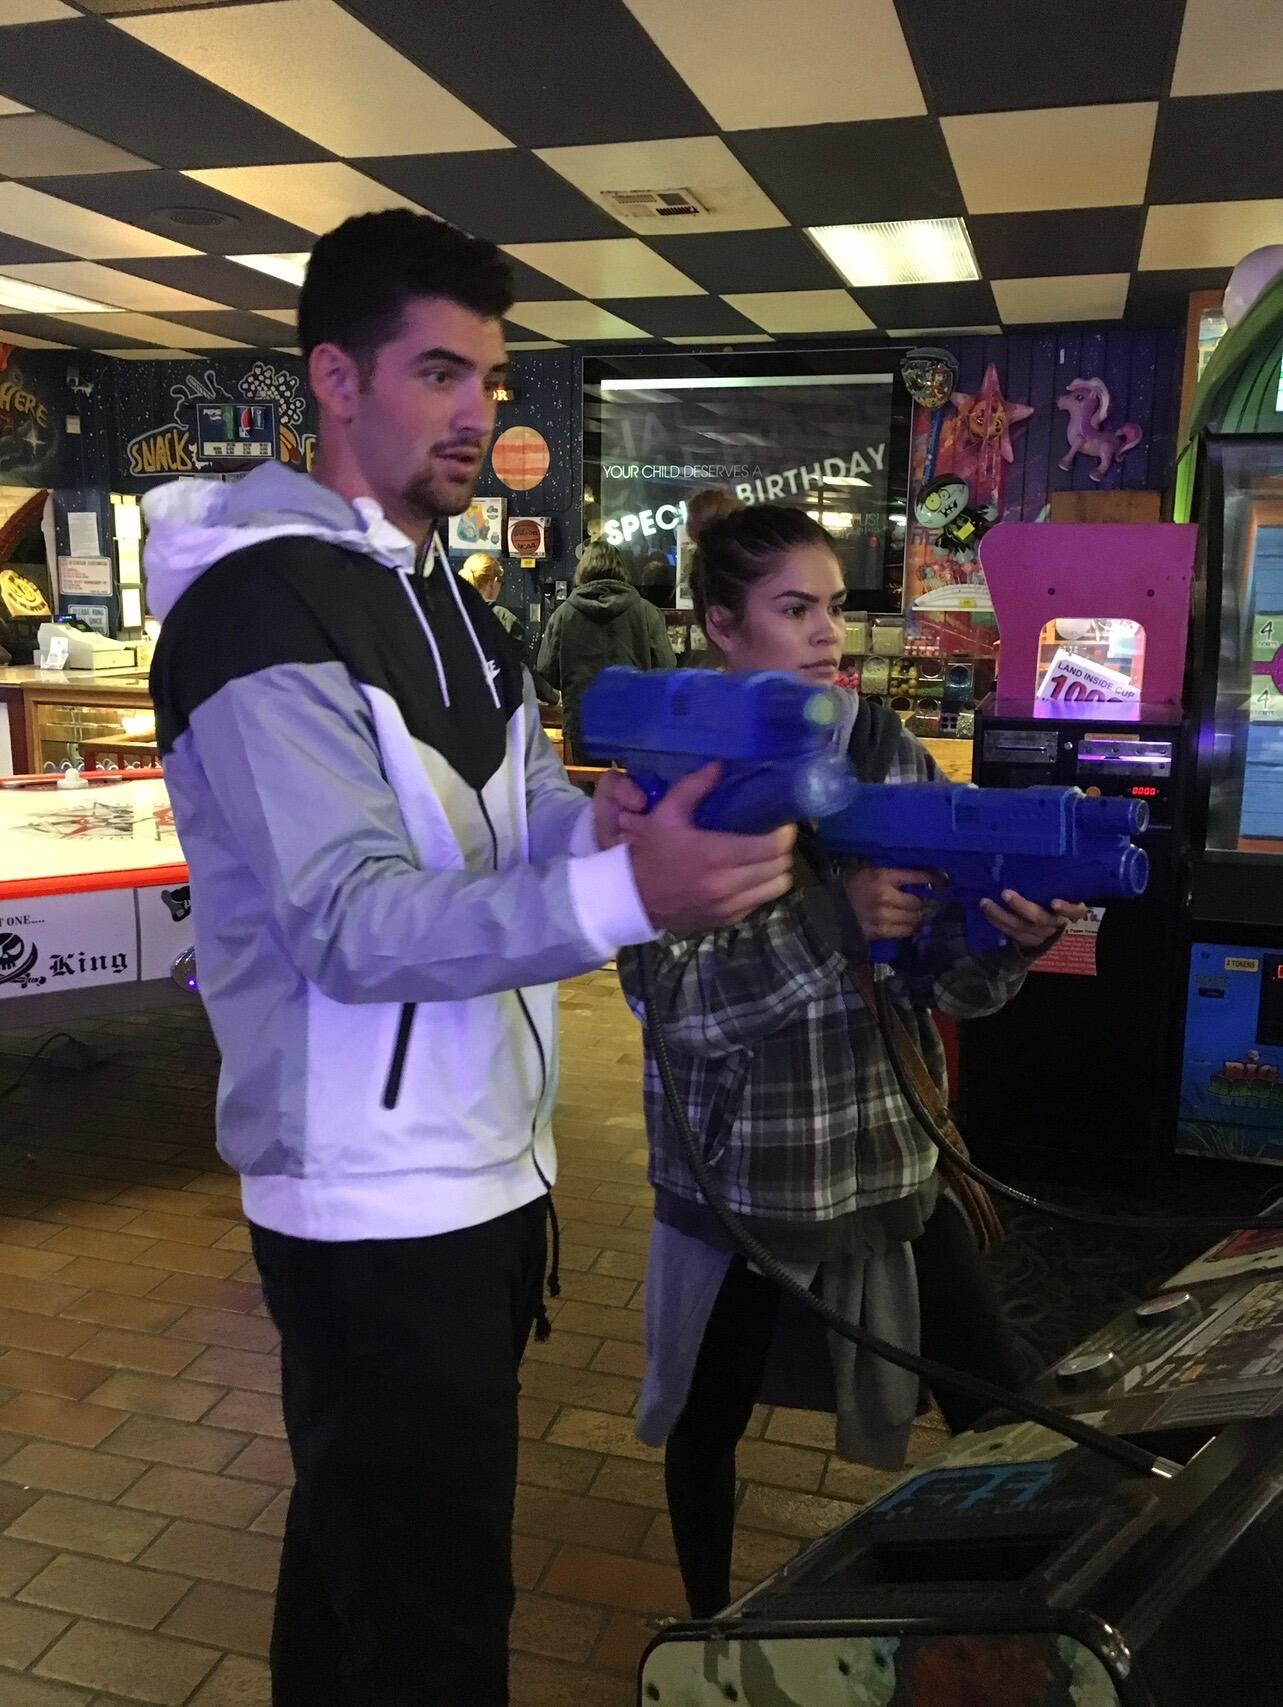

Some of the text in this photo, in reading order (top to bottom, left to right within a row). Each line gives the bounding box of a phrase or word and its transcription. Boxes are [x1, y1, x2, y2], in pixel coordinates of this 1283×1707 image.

[131, 430, 193, 473] SNACK
[602, 464, 763, 479] YOUR CHILD DESERVES A
[604, 443, 886, 546] SPECI BIRTHDAY
[1260, 620, 1273, 640] 4
[1057, 661, 1135, 698] LAND INSIDE CUP
[1257, 689, 1269, 709] 4
[49, 951, 128, 978] King
